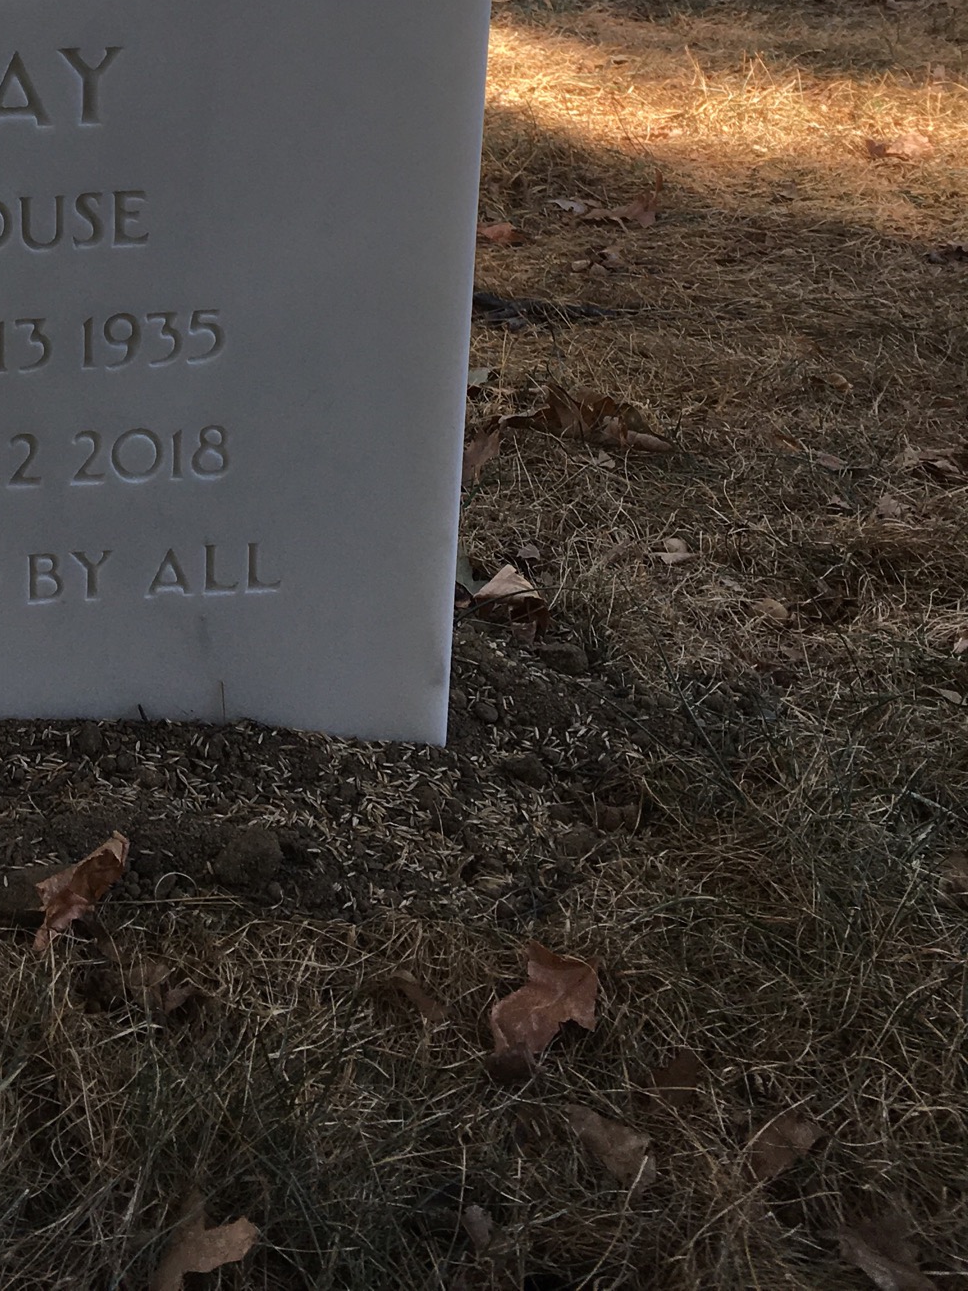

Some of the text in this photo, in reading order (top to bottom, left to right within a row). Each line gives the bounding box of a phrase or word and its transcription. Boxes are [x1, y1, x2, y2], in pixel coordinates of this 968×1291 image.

[80, 309, 227, 372] 1935
[69, 424, 231, 486] 2018
[26, 549, 113, 606] BY
[144, 542, 282, 600] ALL
